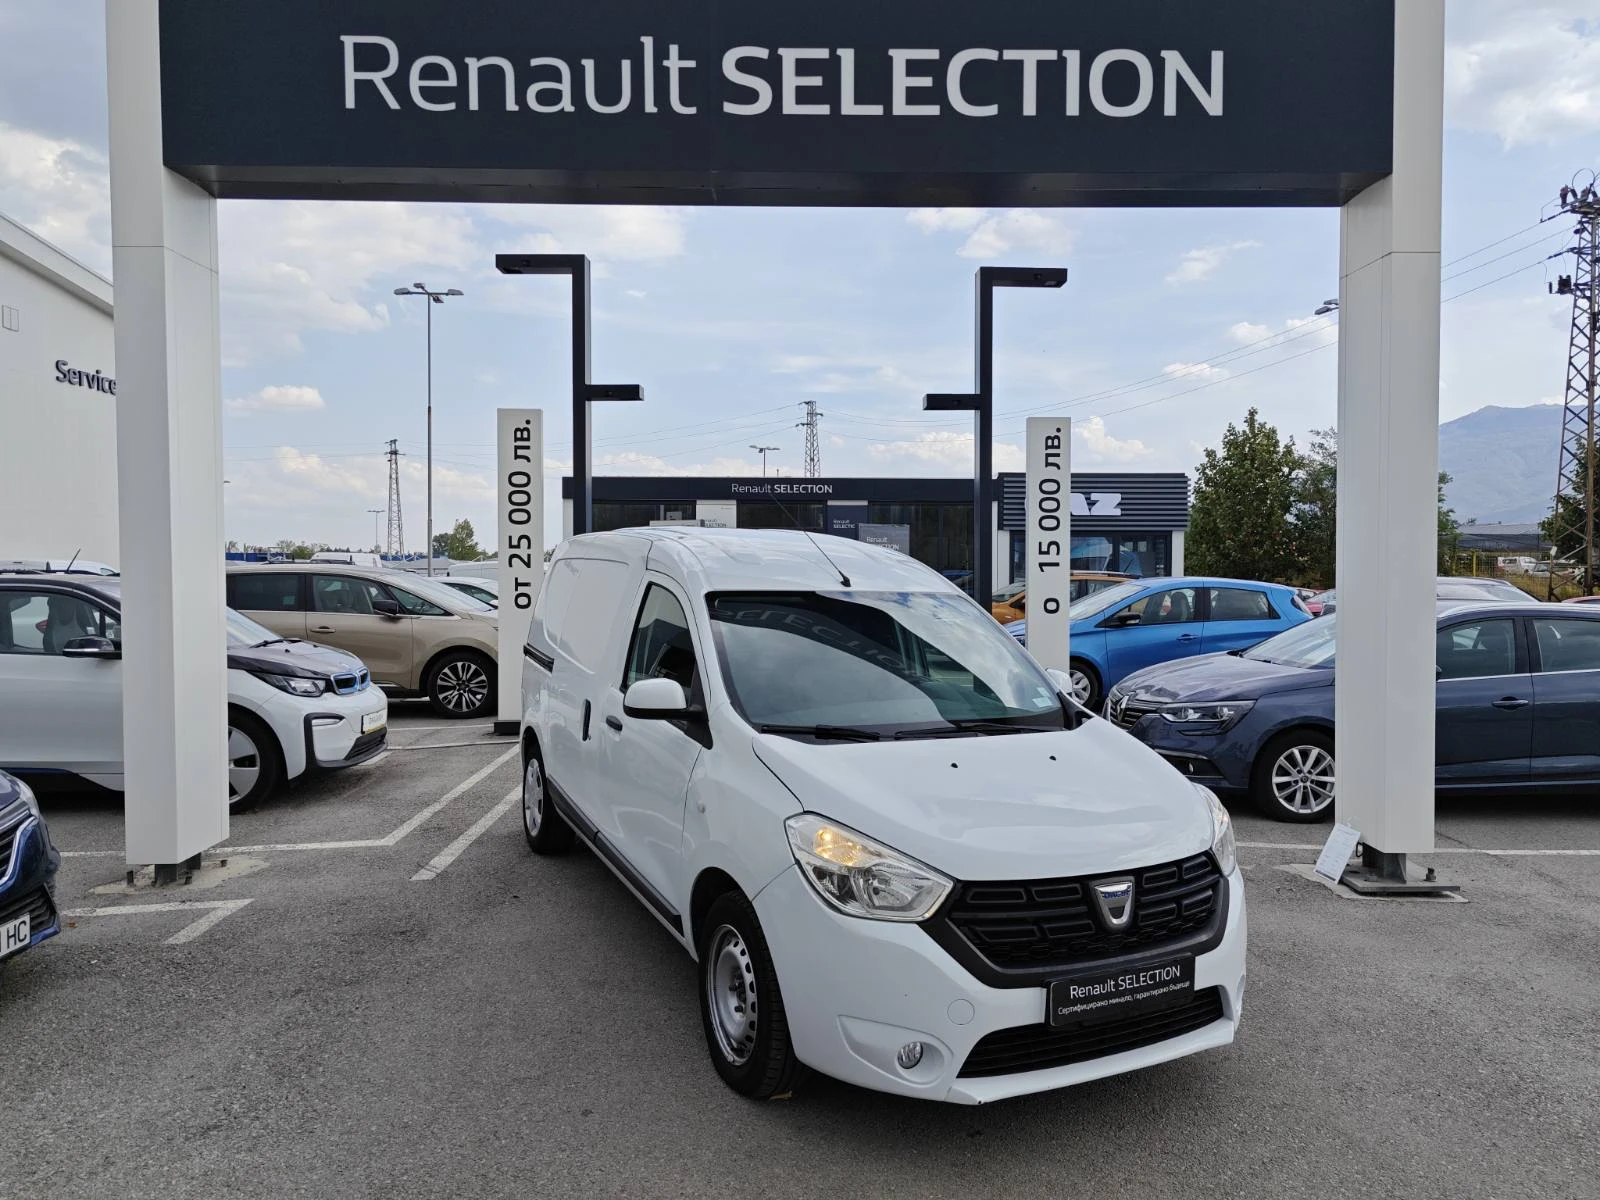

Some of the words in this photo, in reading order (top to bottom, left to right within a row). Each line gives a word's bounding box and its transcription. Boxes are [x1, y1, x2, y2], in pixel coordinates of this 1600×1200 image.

[339, 34, 697, 115] Renault
[721, 45, 1225, 119] SELECTION
[55, 359, 117, 397] Service
[513, 419, 532, 462] лв.
[1044, 427, 1062, 471] лв.
[507, 471, 532, 525] 000
[731, 484, 772, 493] Renault
[774, 484, 833, 494] SELECTION
[1038, 478, 1062, 531] 000
[508, 534, 532, 569] 25
[1038, 540, 1061, 573] 15
[514, 577, 532, 610] от
[1070, 978, 1116, 999] Renault
[1118, 965, 1181, 990] SELECTION
